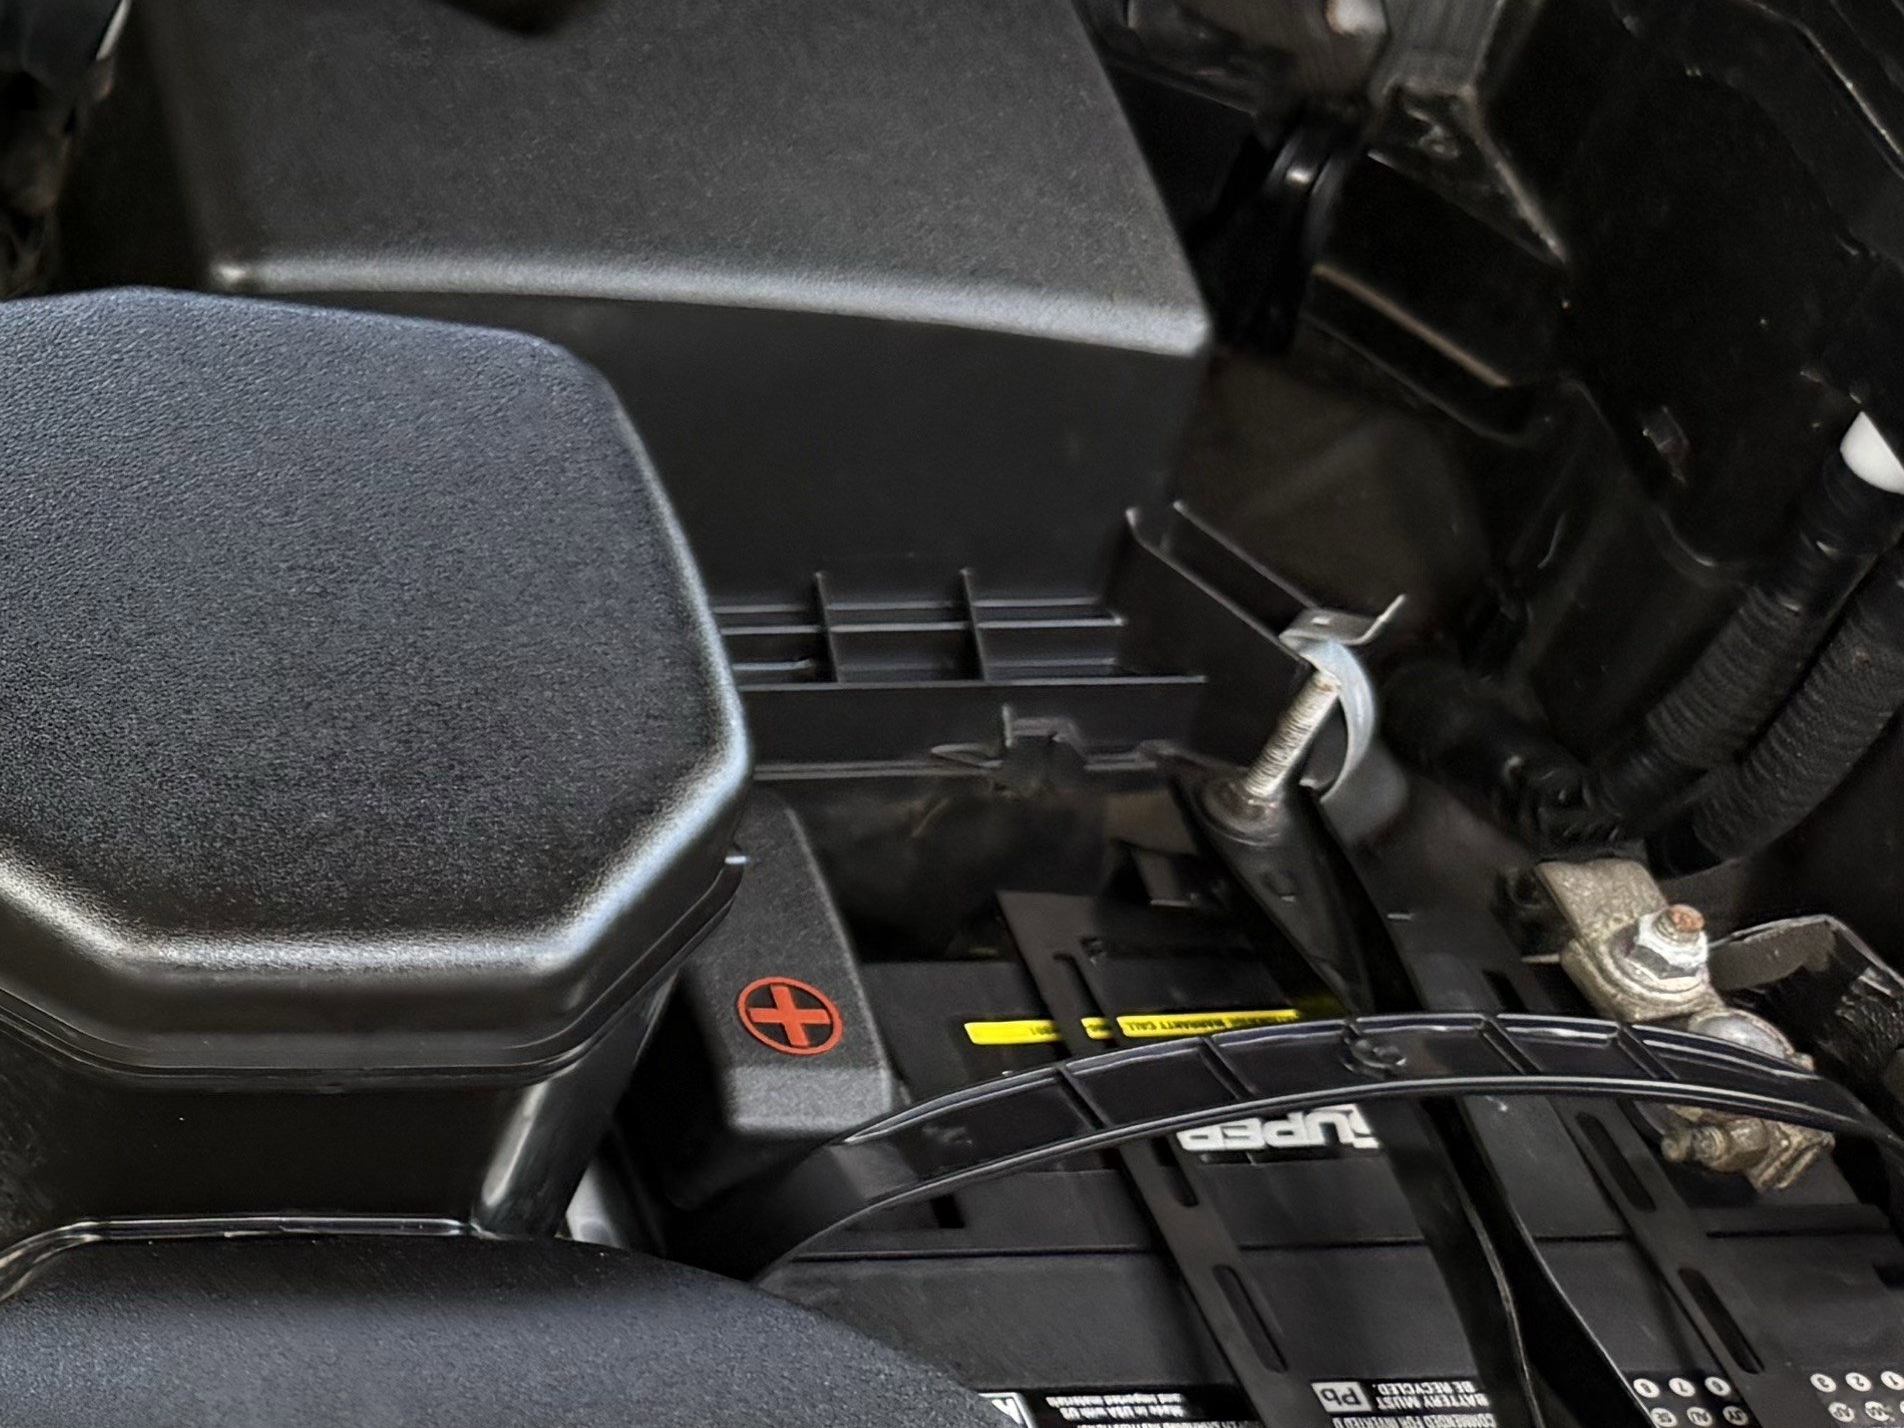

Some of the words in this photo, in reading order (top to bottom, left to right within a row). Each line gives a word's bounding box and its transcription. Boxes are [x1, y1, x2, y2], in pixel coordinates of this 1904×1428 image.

[1372, 1381, 1454, 1396] RECYCLED.
[1452, 1380, 1477, 1395] BE
[1320, 1387, 1362, 1406] Pb
[1375, 1395, 1423, 1411] MUST
[1422, 1393, 1490, 1409] BATTERY
